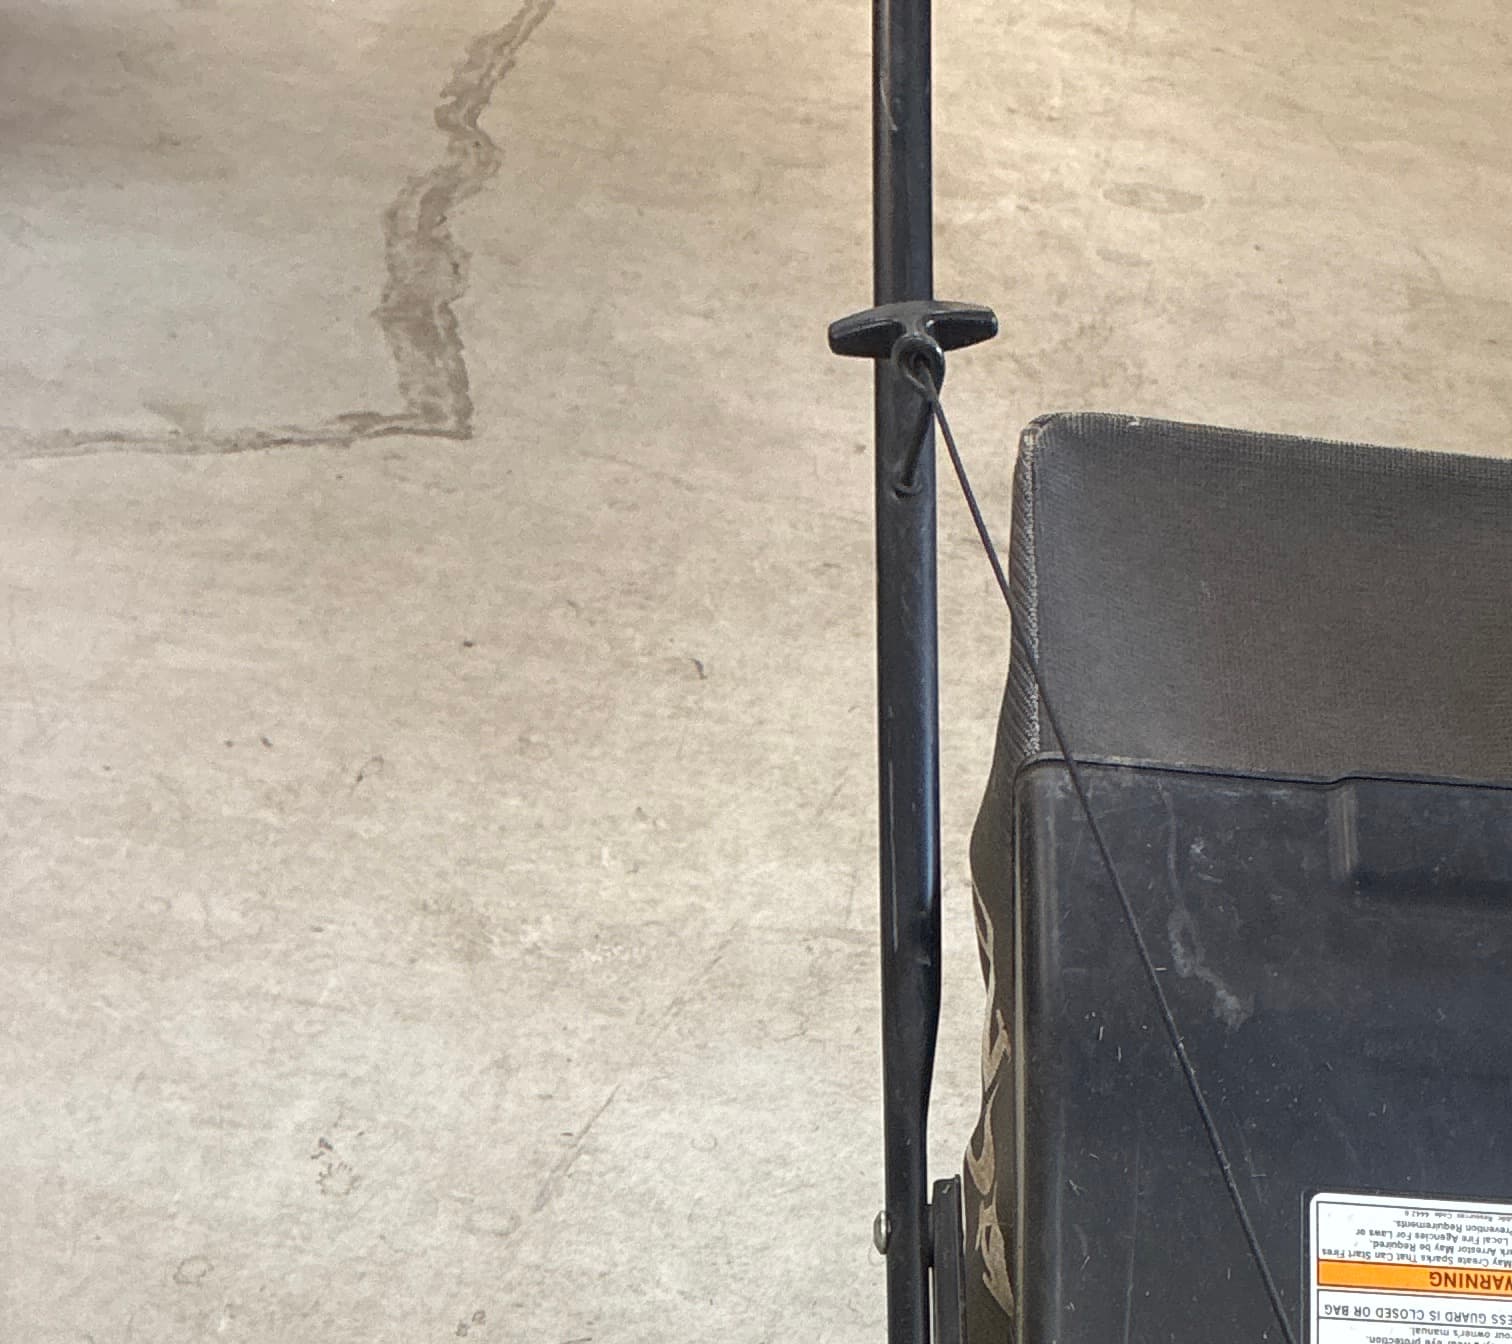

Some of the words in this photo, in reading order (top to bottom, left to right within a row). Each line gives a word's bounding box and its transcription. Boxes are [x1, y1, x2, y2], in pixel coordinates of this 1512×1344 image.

[1370, 1230, 1393, 1239] Laws
[1397, 1232, 1412, 1240] For
[1415, 1231, 1458, 1243] Agencies
[1462, 1236, 1479, 1244] Fire
[1484, 1237, 1509, 1246] Local
[1420, 1244, 1431, 1252] be
[1435, 1243, 1454, 1254] May
[1458, 1246, 1496, 1256] Arrestor
[1323, 1249, 1345, 1258] Fires
[1349, 1250, 1371, 1260] Start
[1376, 1252, 1393, 1261] Can
[1397, 1253, 1418, 1263] That
[1422, 1254, 1453, 1265] Sparks
[1458, 1257, 1489, 1267] Create
[1493, 1258, 1512, 1268] May
[1325, 1305, 1349, 1316] BAG
[1354, 1306, 1371, 1317] OR
[1376, 1308, 1424, 1320] CLOSED
[1430, 1311, 1440, 1321] IS
[1446, 1311, 1486, 1324] GUARD
[1454, 1330, 1491, 1340] owner's
